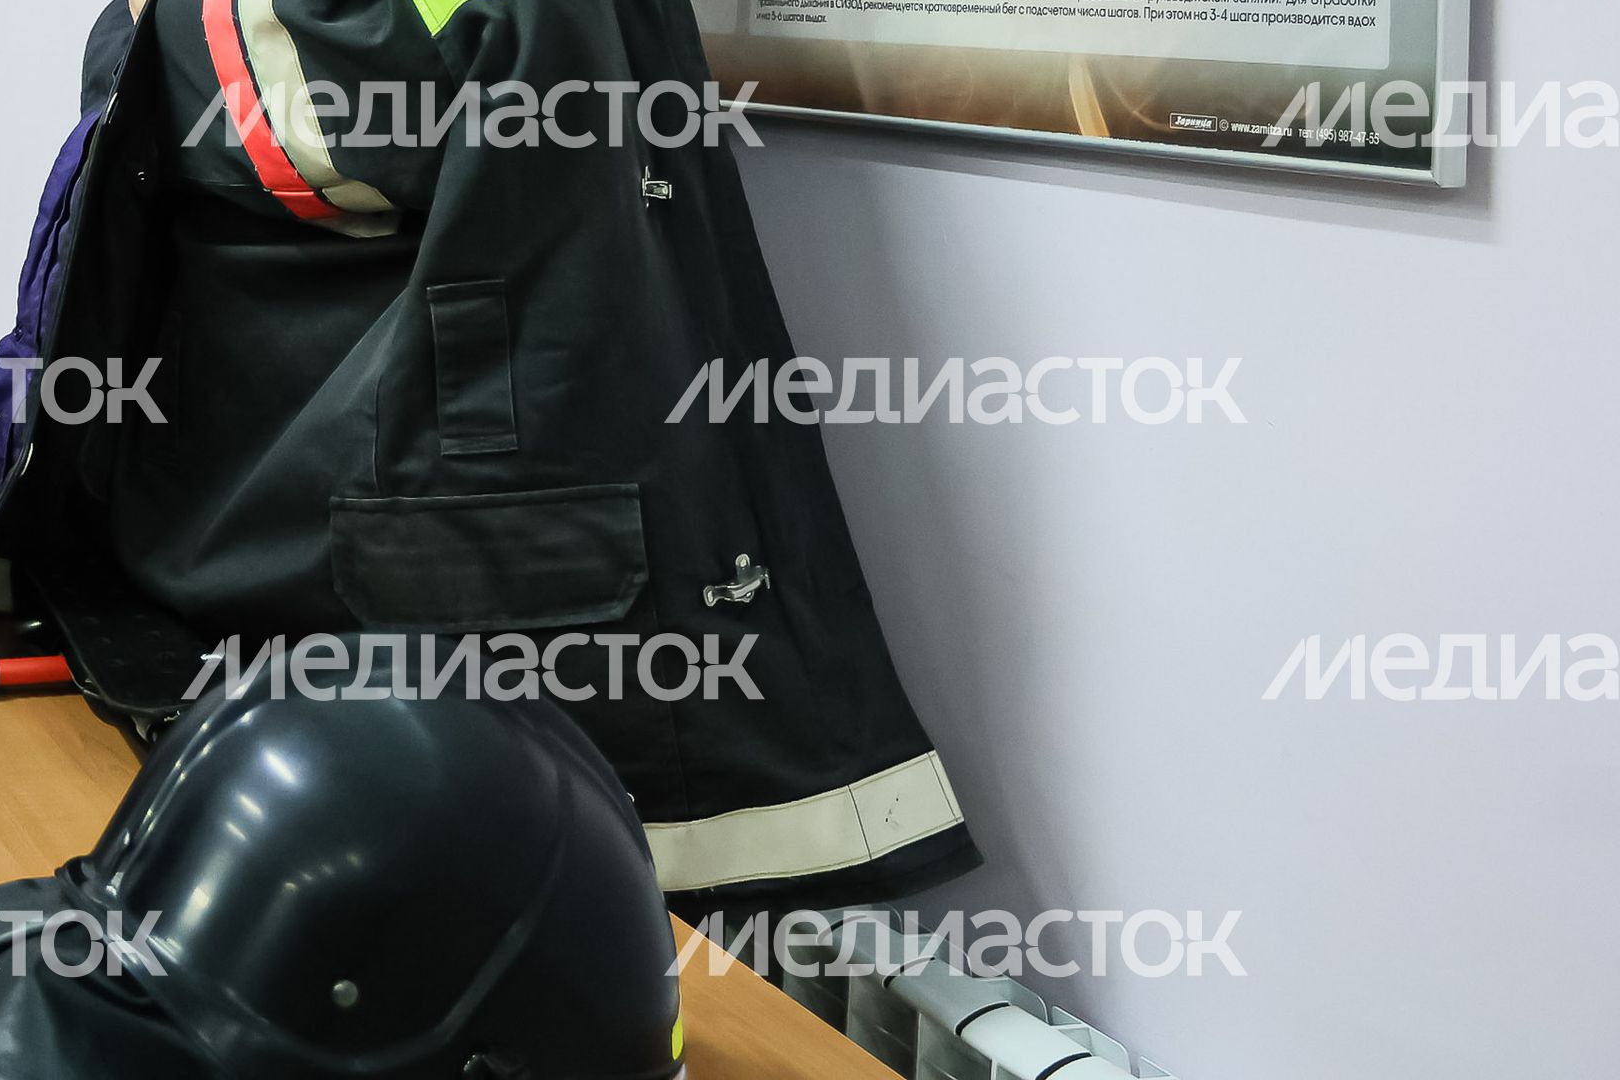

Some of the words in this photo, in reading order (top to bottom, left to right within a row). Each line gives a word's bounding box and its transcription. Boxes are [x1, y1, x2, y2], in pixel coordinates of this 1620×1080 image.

[1208, 7, 1229, 22] 3-4
[1229, 11, 1261, 23] шага
[1260, 12, 1346, 27] производится
[1347, 15, 1377, 29] вдох
[1316, 128, 1337, 143] (495)
[1338, 130, 1380, 146] 987-47-55
